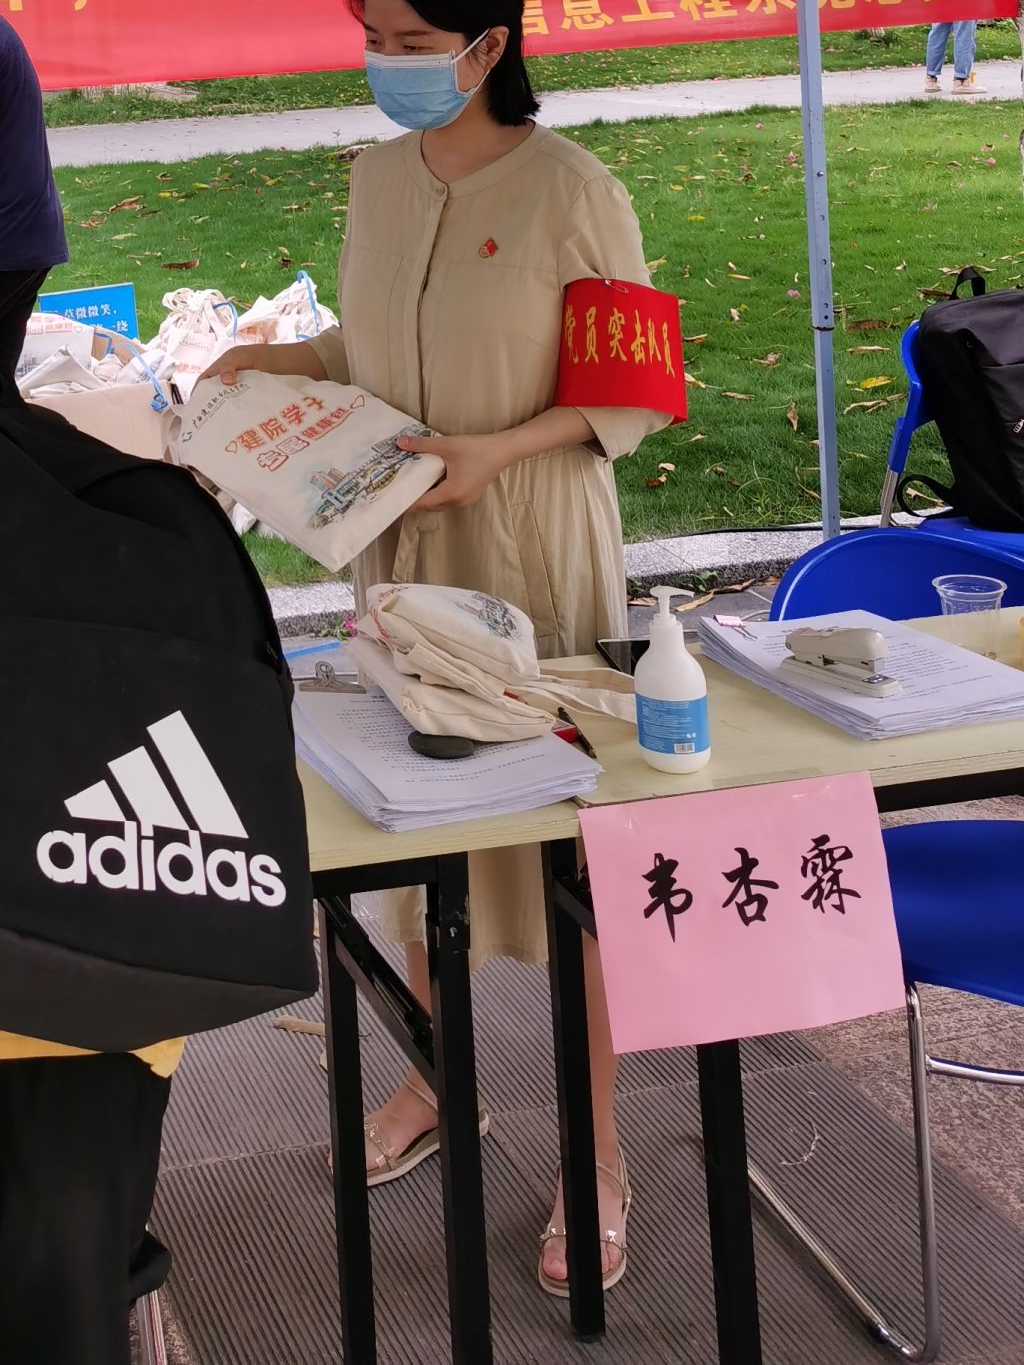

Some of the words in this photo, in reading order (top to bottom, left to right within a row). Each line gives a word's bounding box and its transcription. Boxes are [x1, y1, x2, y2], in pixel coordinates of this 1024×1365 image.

[564, 304, 676, 380] 党员突击队员
[236, 395, 324, 452] 建院学子
[36, 820, 287, 908] adidas
[640, 833, 862, 943] 韦杏霖
